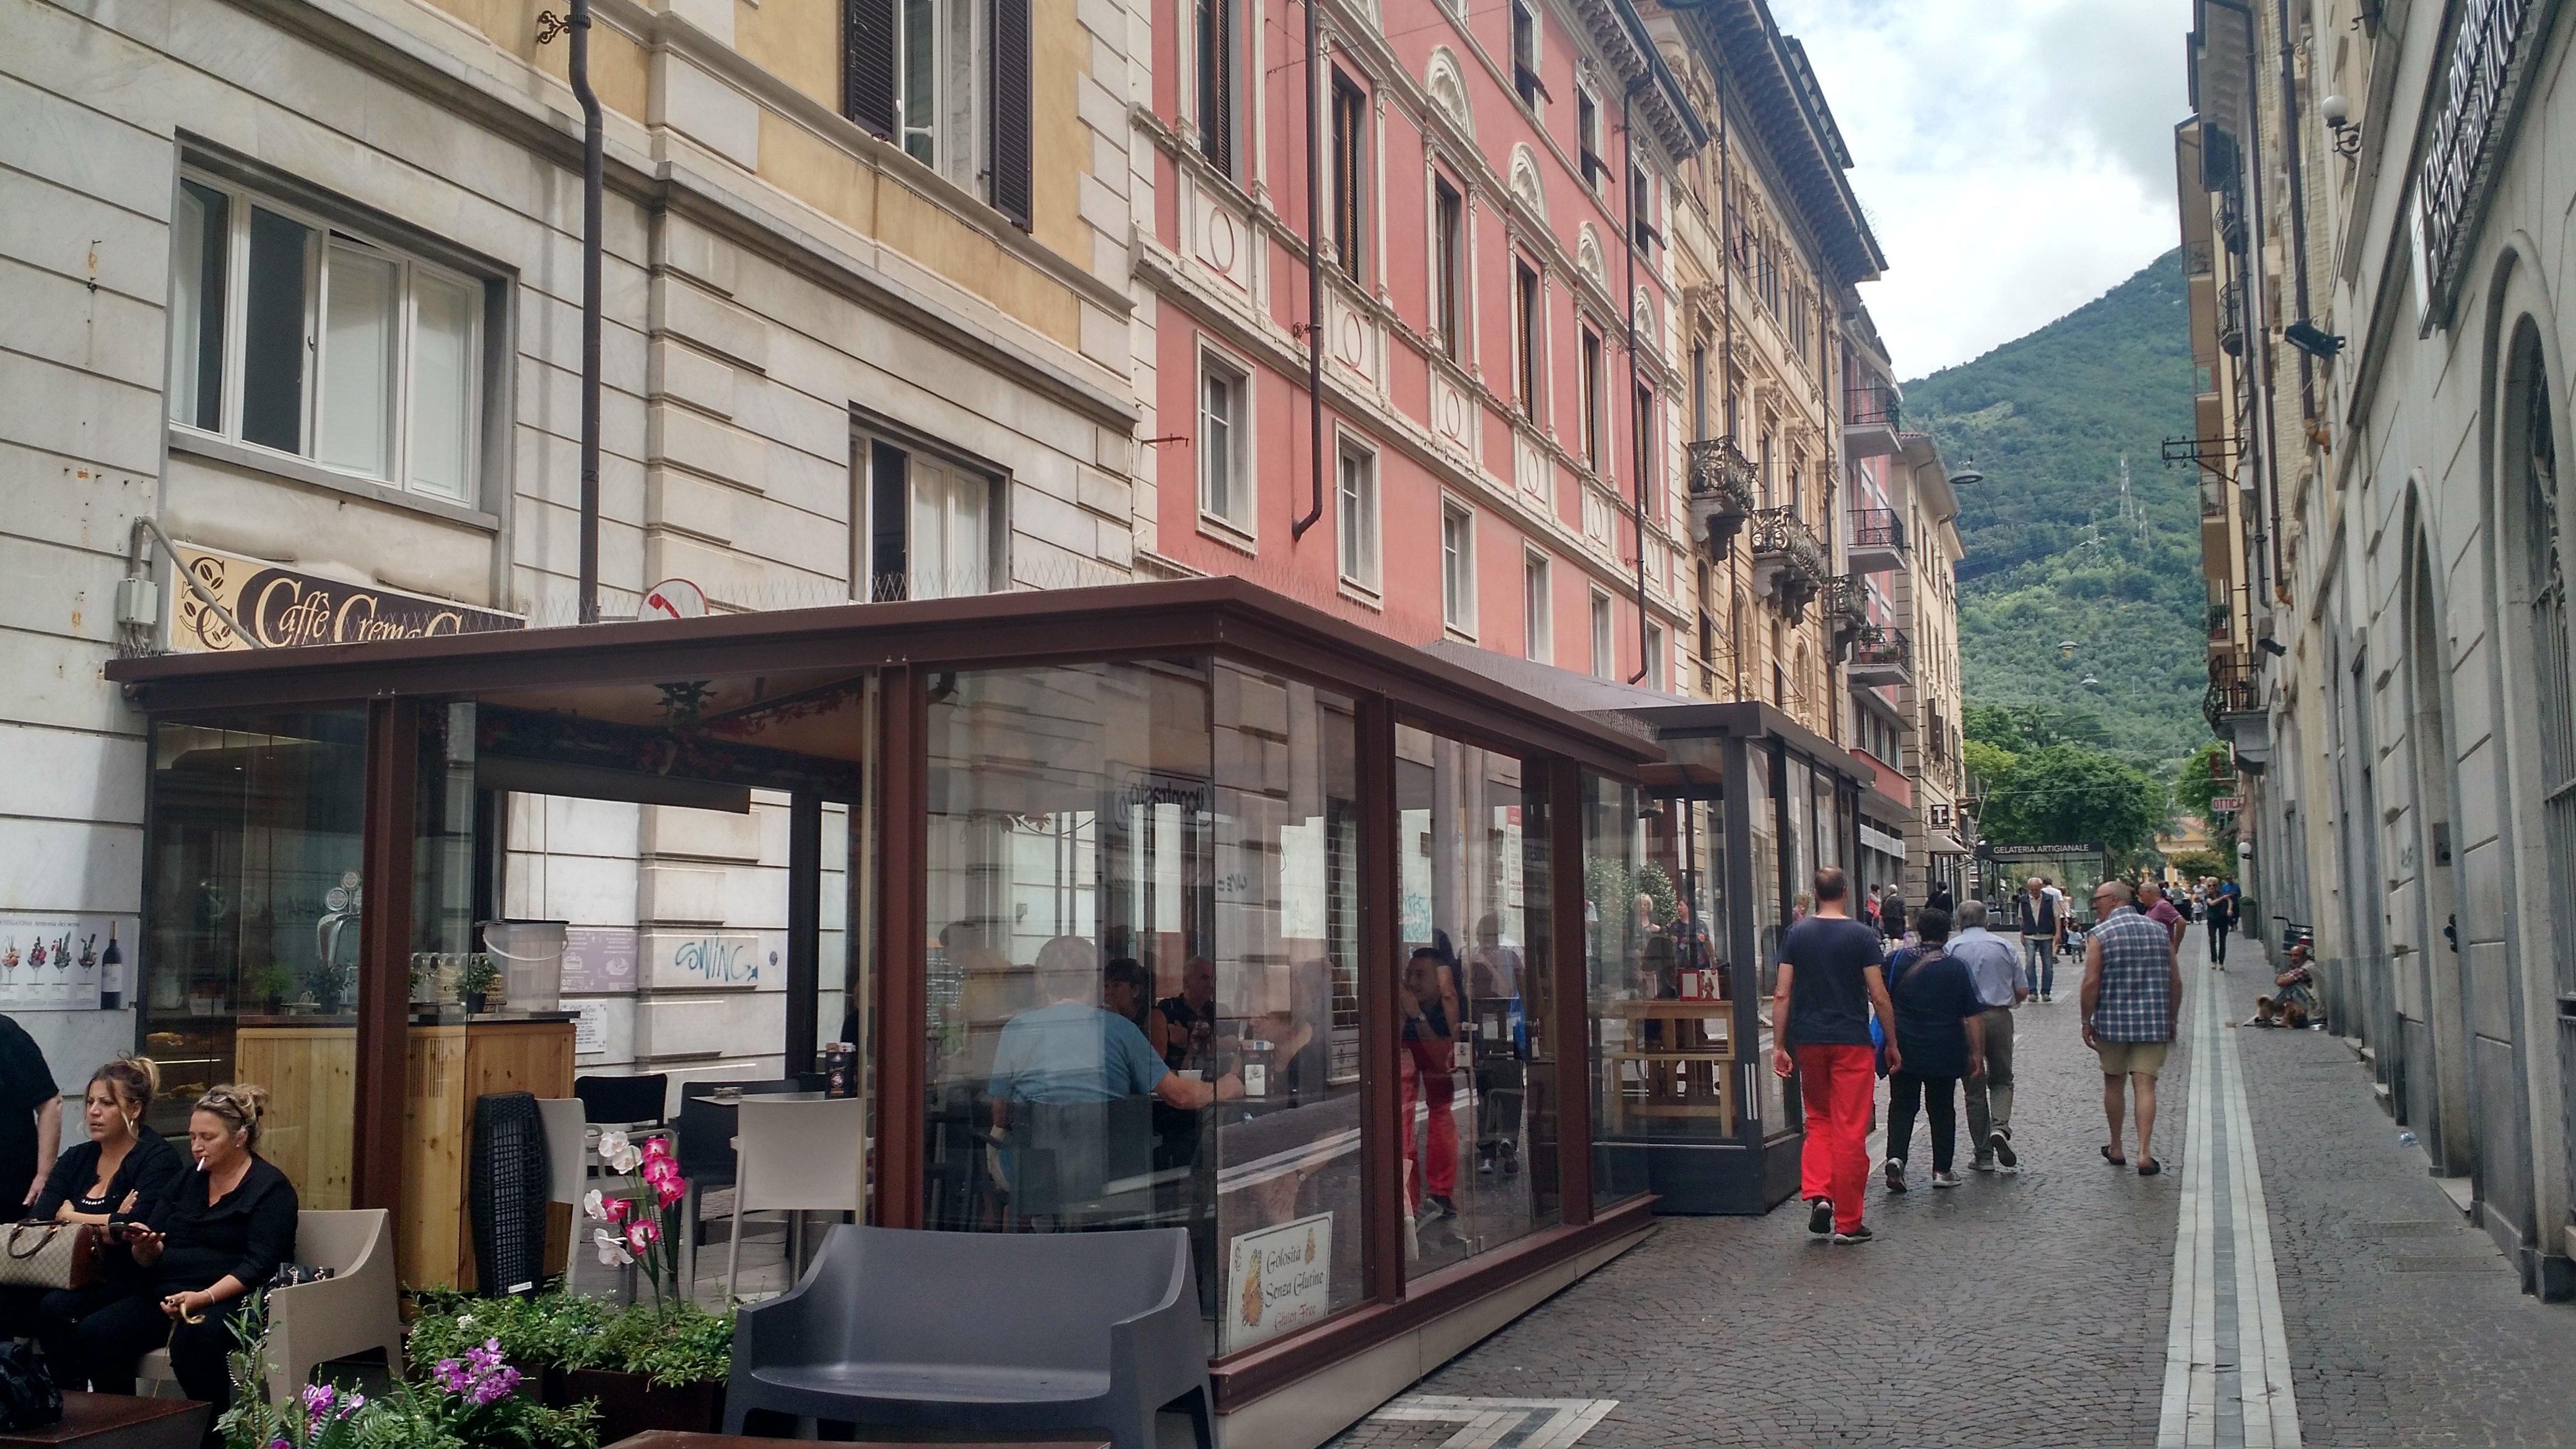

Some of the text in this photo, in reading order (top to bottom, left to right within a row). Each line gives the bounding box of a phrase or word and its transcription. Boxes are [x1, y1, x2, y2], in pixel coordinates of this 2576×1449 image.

[255, 577, 330, 648] Caffè
[2213, 799, 2242, 809] OTTICA
[1993, 844, 2089, 854] GELATERIA ARTIGIANALE
[1264, 1269, 1324, 1308] Senza Glutine
[1274, 1303, 1316, 1331] Gluten Free
